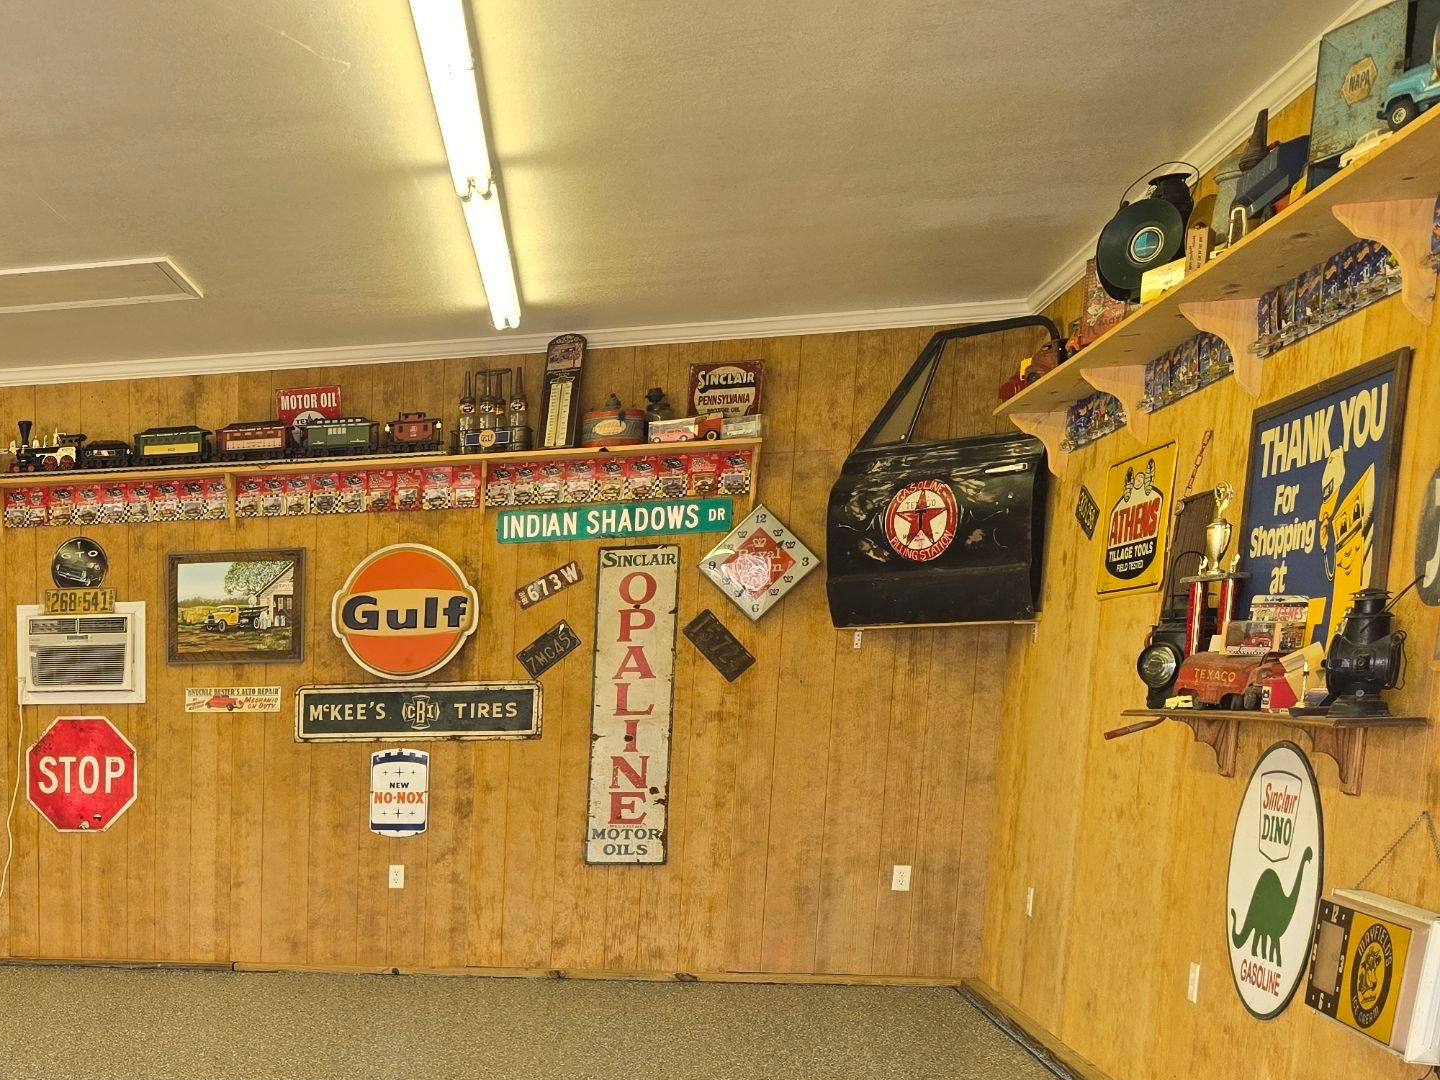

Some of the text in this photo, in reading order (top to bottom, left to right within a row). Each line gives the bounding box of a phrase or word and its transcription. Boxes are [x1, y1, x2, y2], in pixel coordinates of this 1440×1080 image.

[1349, 69, 1371, 92] NAPA
[698, 371, 755, 390] SINCLAIR
[281, 392, 337, 410] MOTOR OIL
[698, 393, 750, 406] PENNSYLVANIA
[1260, 382, 1389, 479] THANK YOU
[897, 480, 945, 503] GASOLINE
[1273, 482, 1300, 516] For
[503, 505, 726, 540] INDIAN SHADOWS DR
[756, 514, 767, 523] 12
[1110, 497, 1161, 545] ATHENS
[920, 530, 953, 561] STATION
[1249, 518, 1316, 559] Shopping
[61, 550, 98, 559] GTO
[602, 551, 677, 568] SINCLAIR
[801, 557, 809, 566] 3
[1109, 541, 1154, 562] TILLAGE TOOLS
[709, 561, 716, 570] 9
[1128, 559, 1144, 570] TESTED
[1269, 560, 1288, 595] at
[341, 595, 468, 631] Gulf
[752, 604, 759, 612] 6
[1194, 668, 1236, 682] TEXACO
[608, 571, 657, 825] OPALINE
[310, 701, 386, 722] McKEE'S
[454, 702, 517, 719] TIRES
[38, 755, 126, 794] STOP
[1262, 783, 1298, 810] Sinclair
[592, 828, 661, 840] MOTOR
[1261, 813, 1292, 846] DINO
[603, 844, 648, 856] OILS
[1358, 925, 1393, 967] MAYFIELD'S
[1240, 958, 1282, 997] GASOLINE
